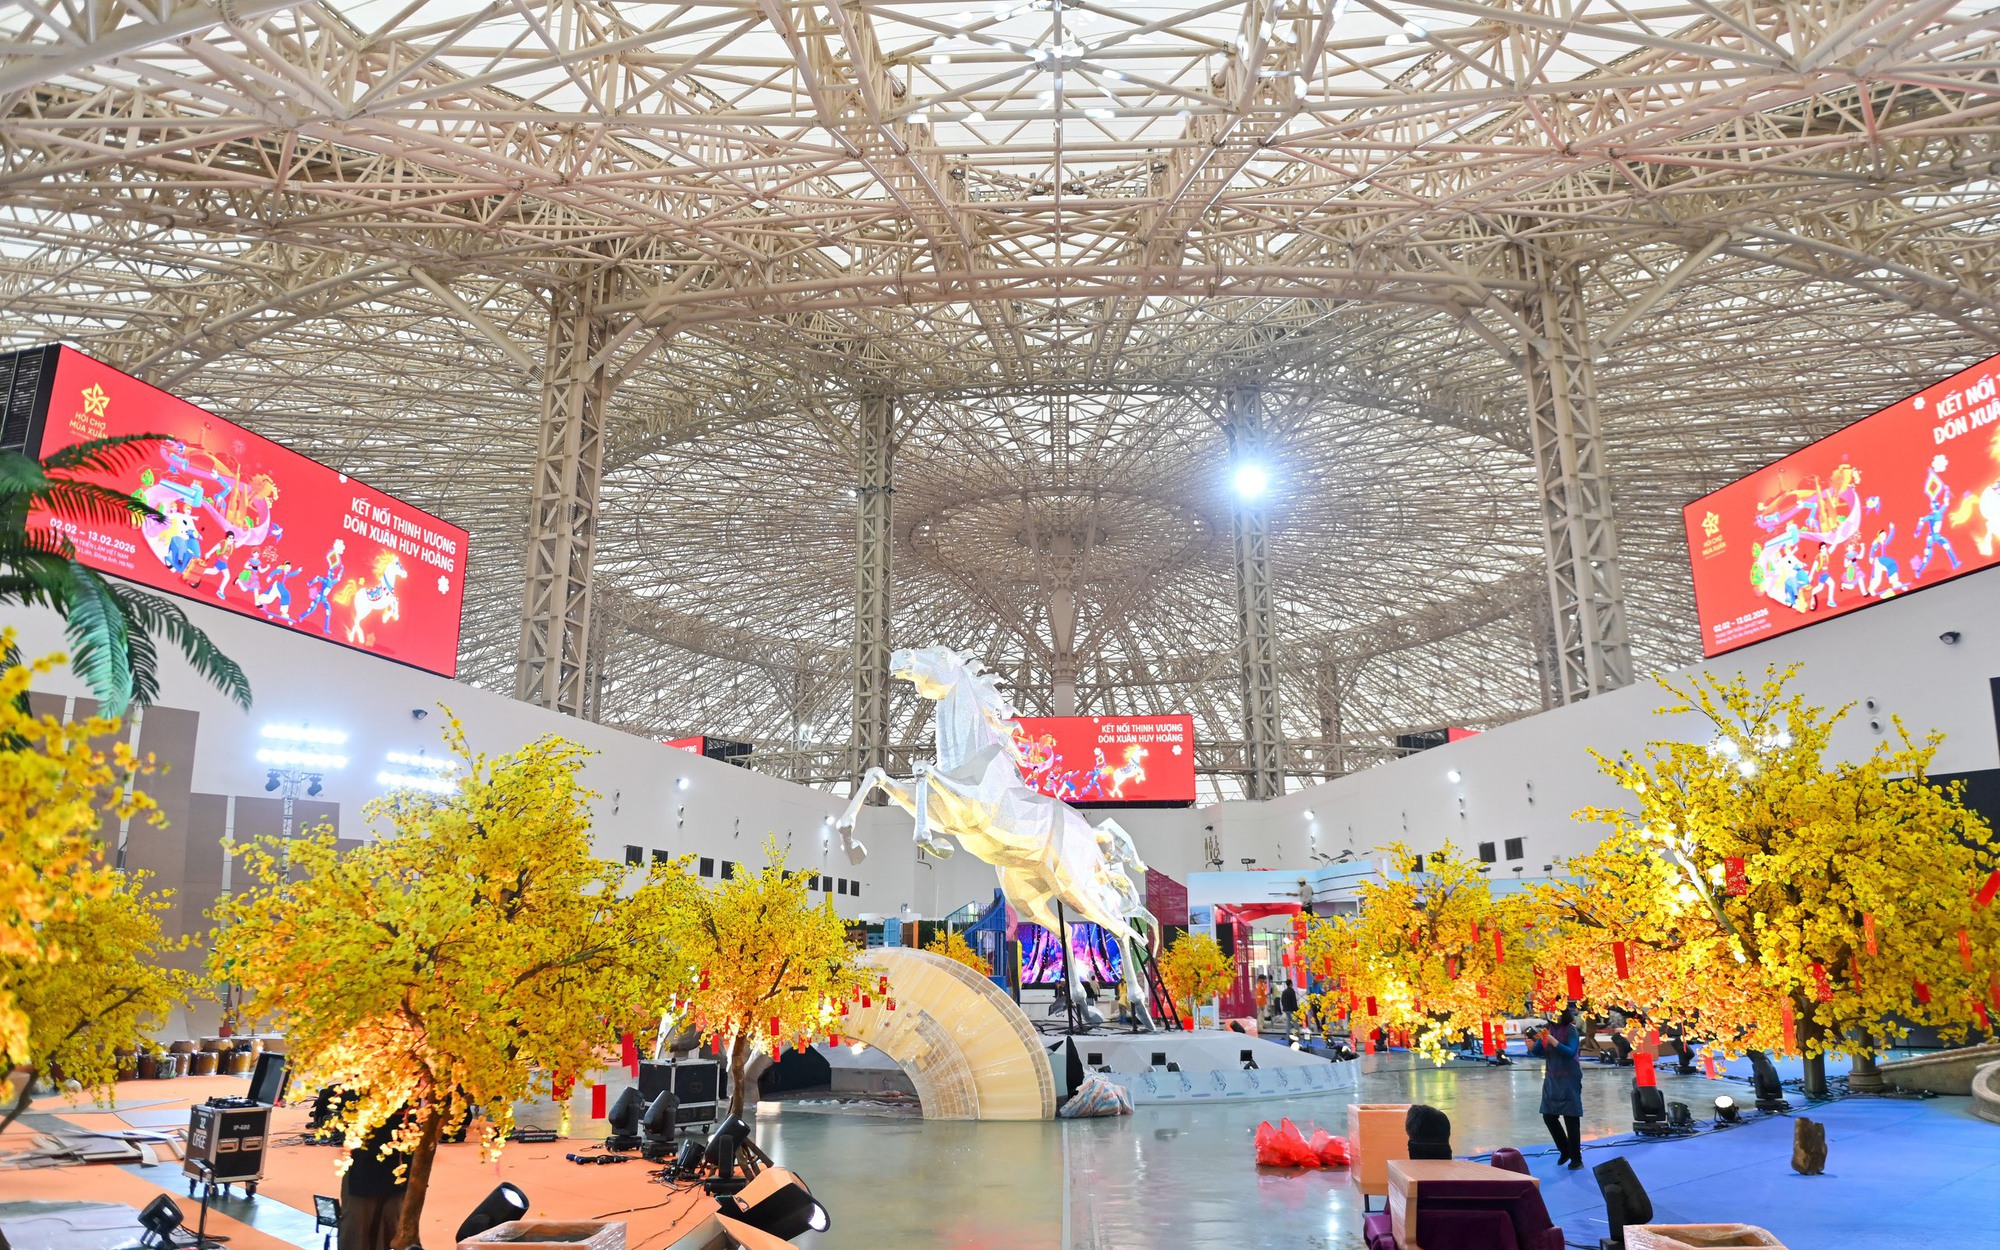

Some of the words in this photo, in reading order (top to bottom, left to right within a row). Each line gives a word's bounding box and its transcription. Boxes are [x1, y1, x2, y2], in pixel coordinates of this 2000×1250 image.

[1936, 390, 1962, 419] KẾT
[1965, 373, 1996, 406] NỐI
[1933, 416, 1968, 444] ĐÓN
[50, 517, 77, 535] 02.02
[87, 531, 136, 554] 13.02.2026
[342, 514, 367, 536] ĐÓN
[368, 526, 397, 550] XUÂN
[398, 540, 419, 558] HUY
[420, 550, 454, 573] HOÀNG
[351, 496, 371, 518] KẾT
[371, 507, 391, 527] NỐI
[392, 515, 421, 538] THỊNH
[423, 528, 457, 555] VƯỢNG
[1101, 723, 1114, 733] KẾT
[1116, 722, 1130, 733] NỐI
[1131, 724, 1154, 734] THỊNH
[1155, 723, 1183, 734] VƯỢNG
[1116, 732, 1137, 743] XUÂN
[1138, 734, 1154, 743] HUY
[1156, 732, 1183, 743] HOÀNG
